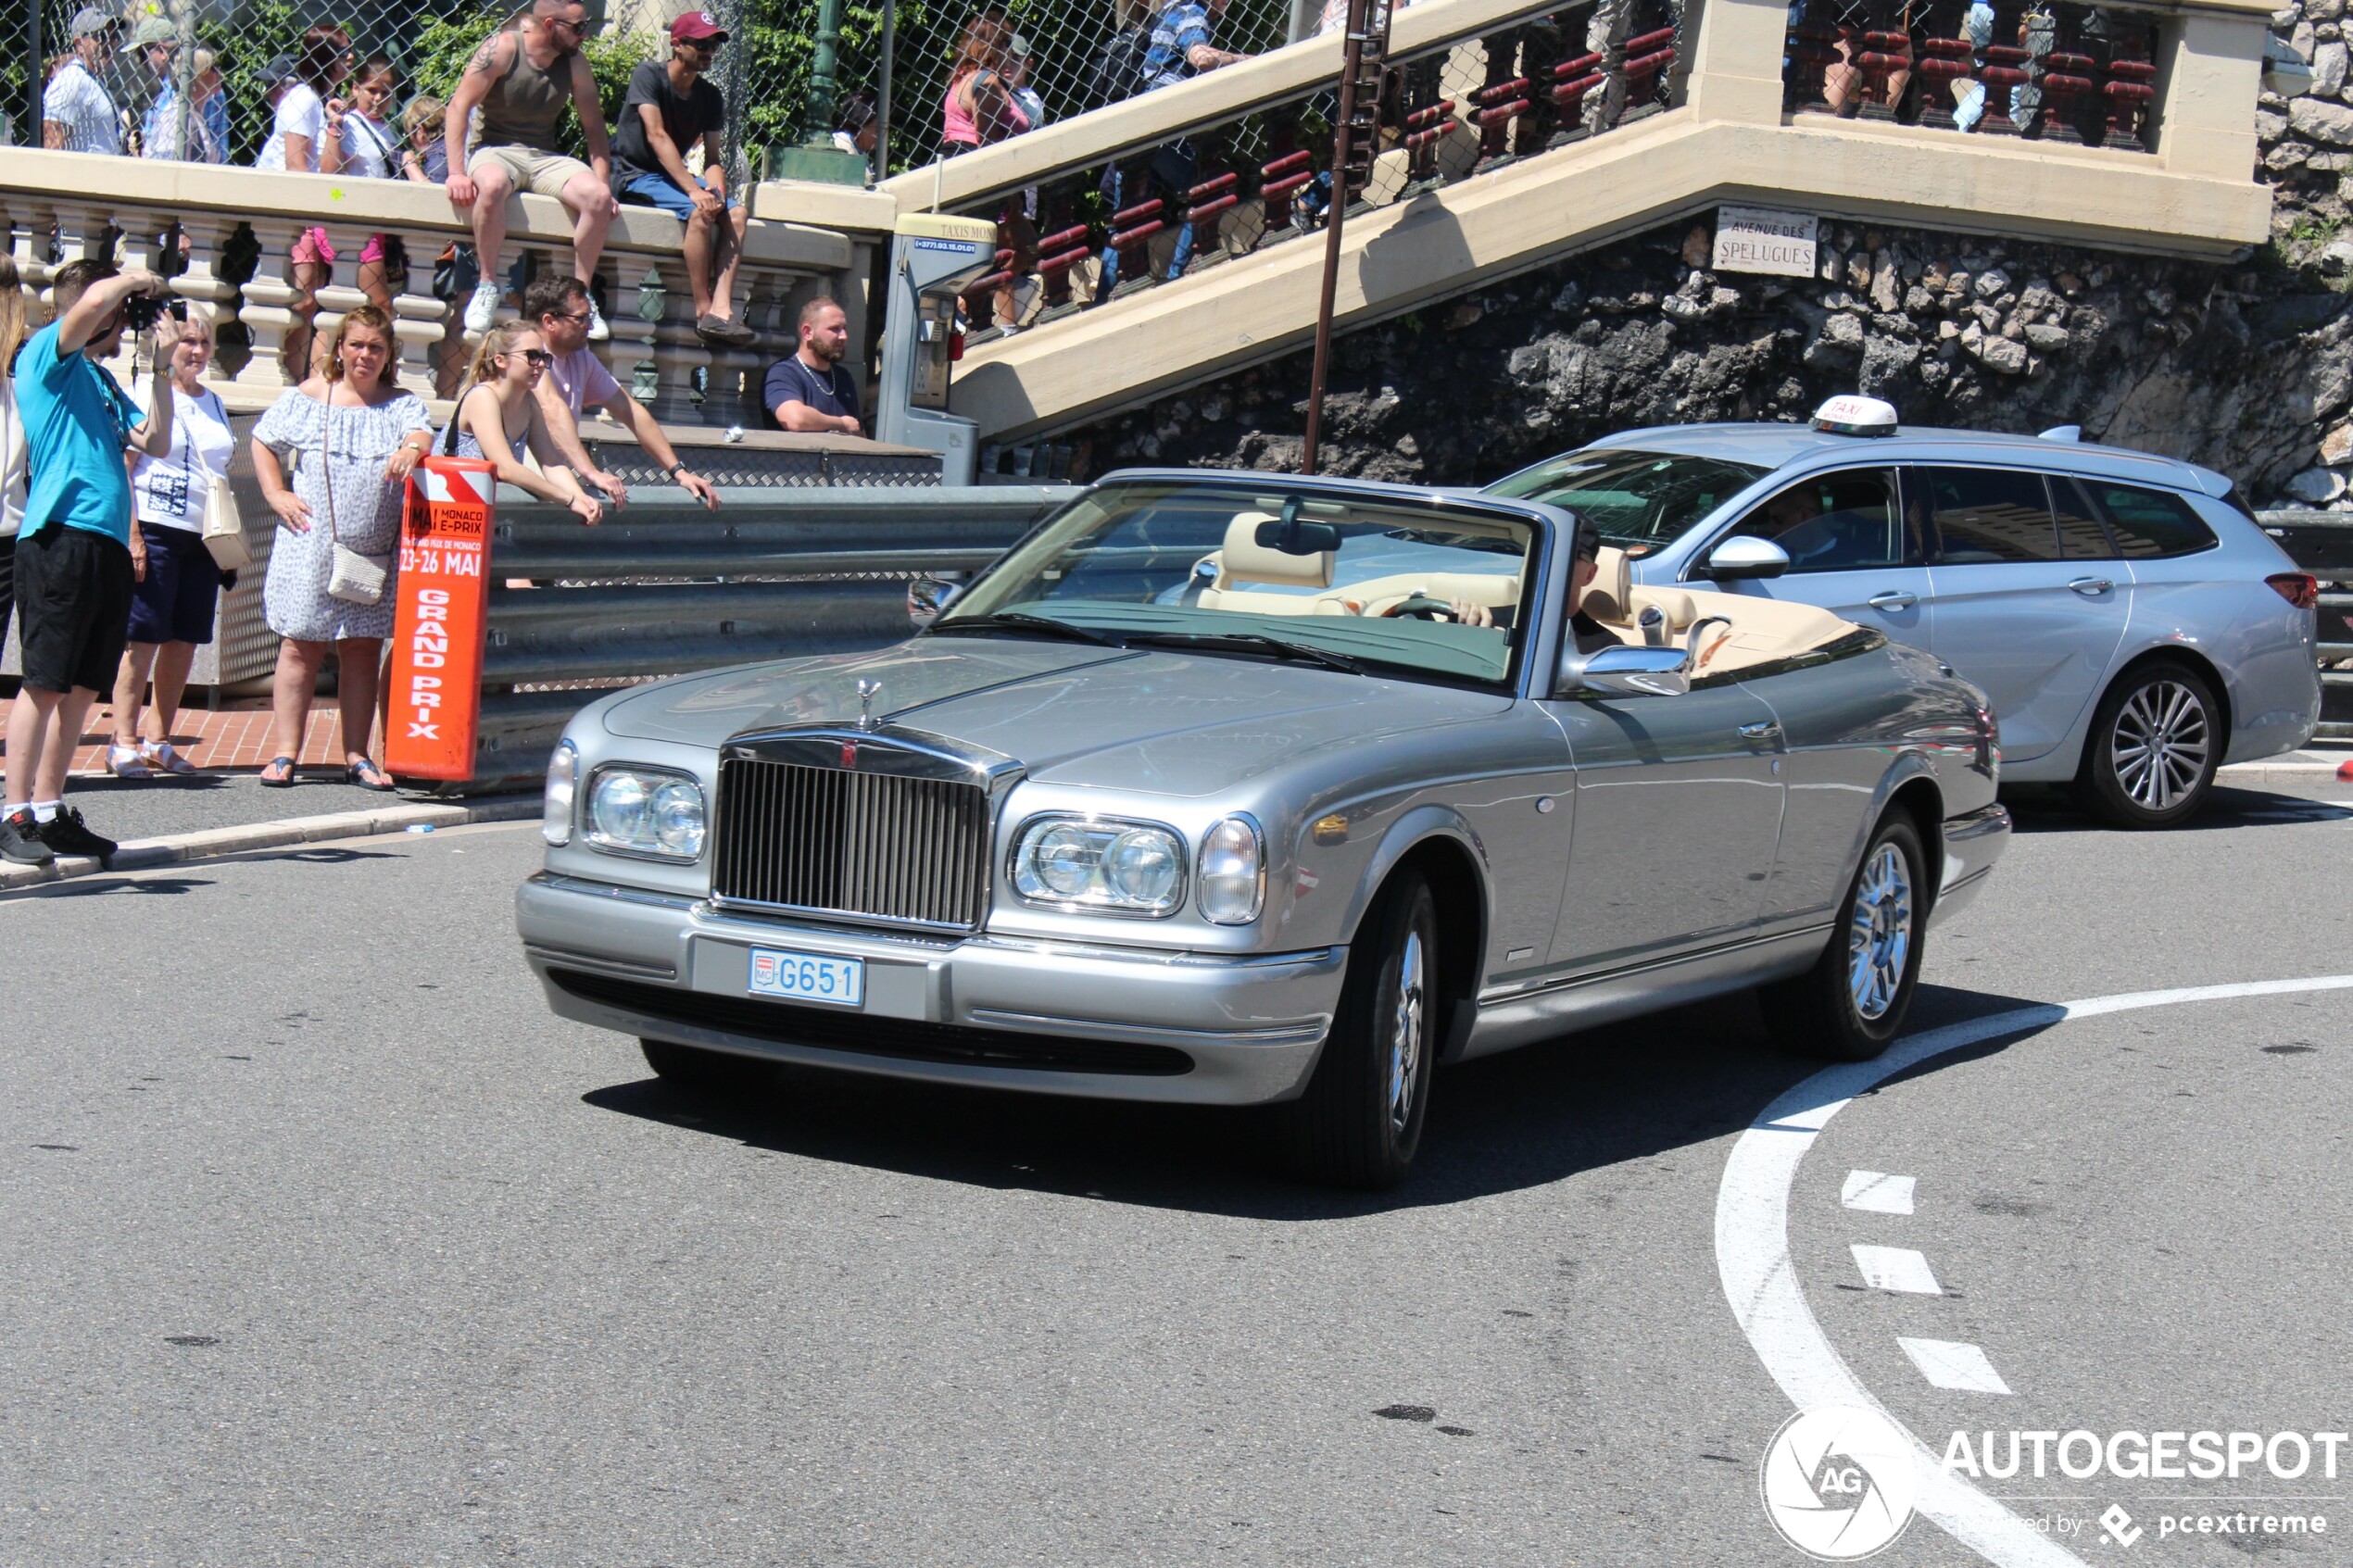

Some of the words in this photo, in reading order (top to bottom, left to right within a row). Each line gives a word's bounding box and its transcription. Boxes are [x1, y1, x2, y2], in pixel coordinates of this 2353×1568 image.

[941, 224, 970, 238] TAXIS
[1731, 221, 1778, 235] AVENUE
[1783, 225, 1805, 238] DES
[1720, 242, 1813, 265] SPELUGUES
[1831, 401, 1863, 415] TAXI
[441, 509, 483, 521] MONACO
[440, 520, 482, 533] E-PRIX
[445, 540, 453, 549] DE
[454, 541, 481, 551] MONACO
[399, 548, 439, 574] 23-26
[445, 551, 481, 576] MAI
[413, 588, 449, 668] GRAND
[407, 675, 442, 740] PRIX
[780, 959, 851, 996] G651
